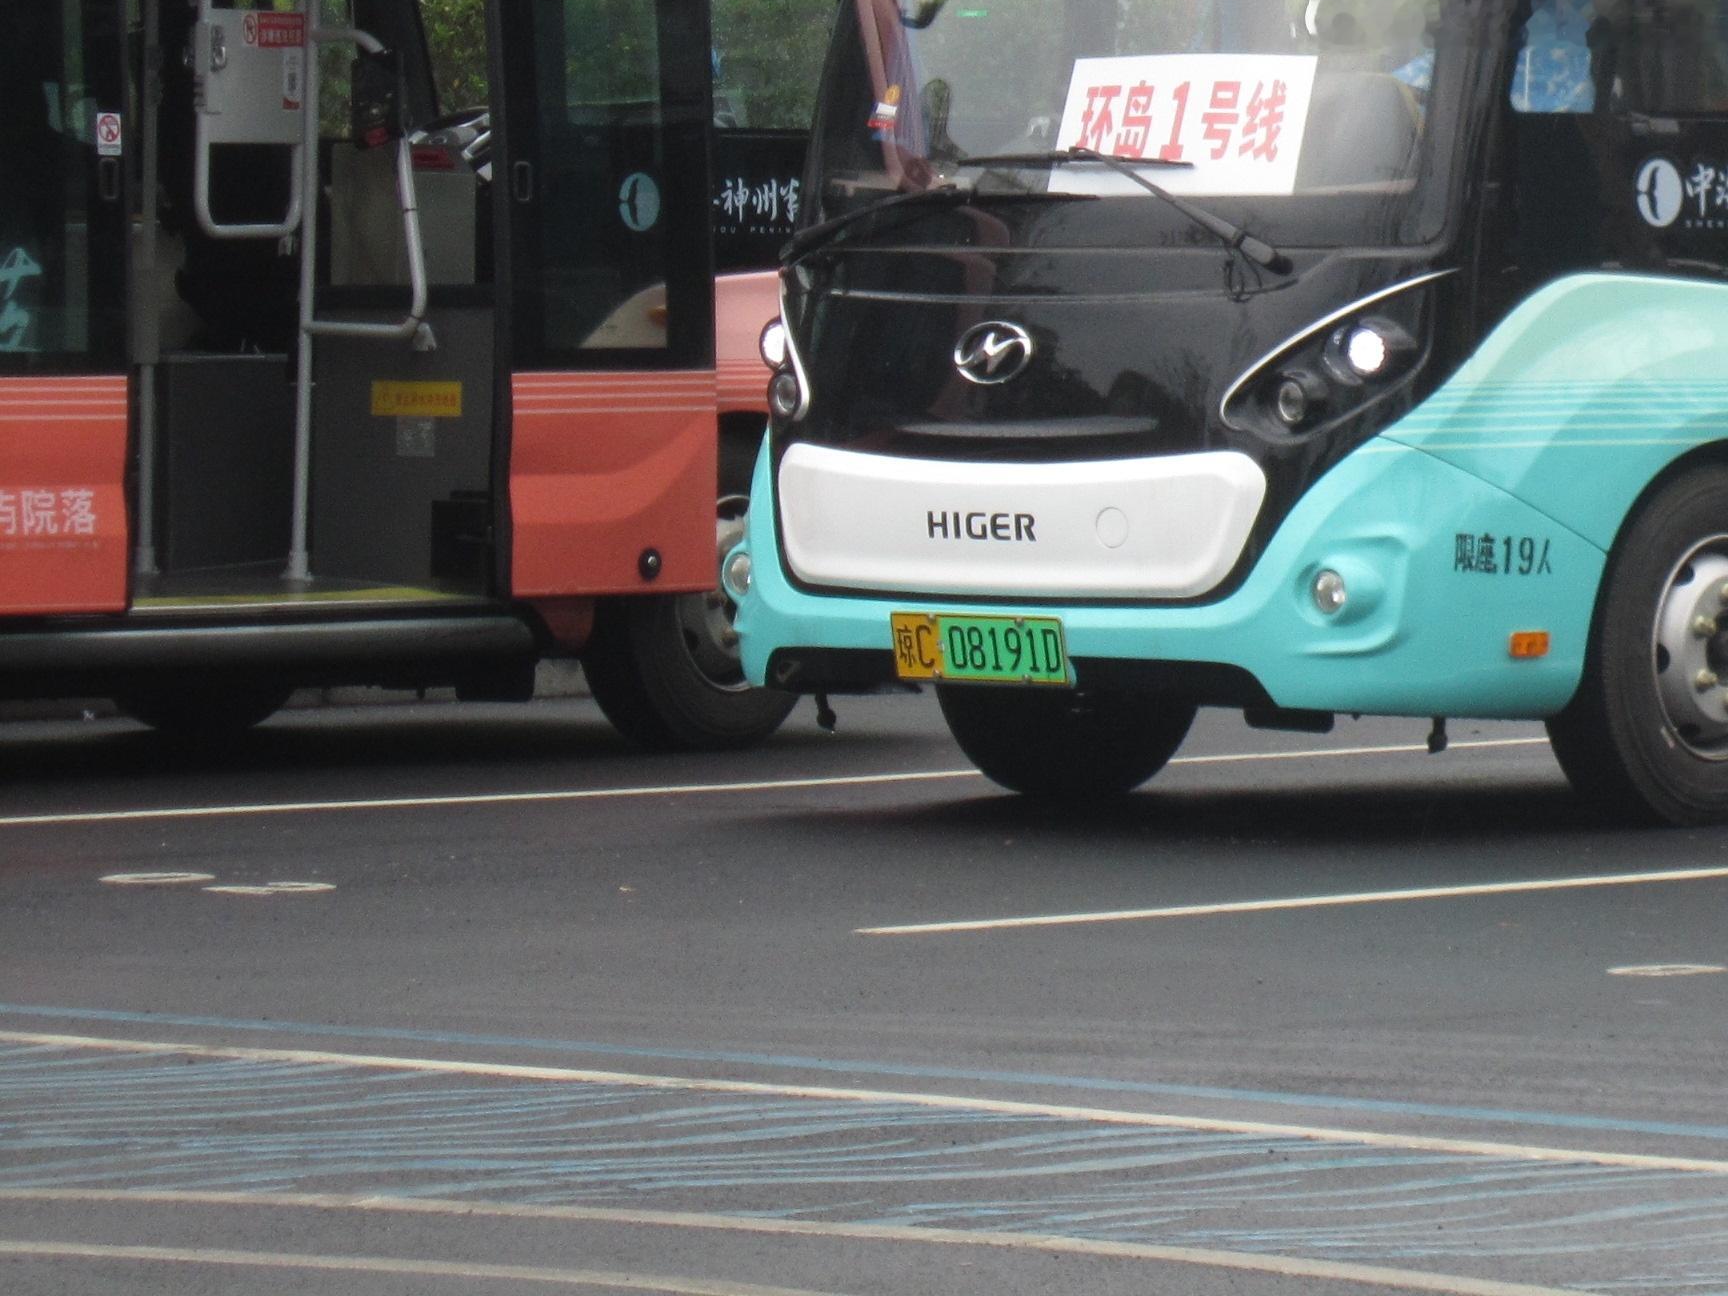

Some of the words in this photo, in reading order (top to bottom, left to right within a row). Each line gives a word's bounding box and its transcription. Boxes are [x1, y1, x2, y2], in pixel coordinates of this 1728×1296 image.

[1076, 79, 1288, 162] 环岛1号线
[926, 510, 1037, 542] HIGER
[1454, 532, 1552, 575] 限座19人
